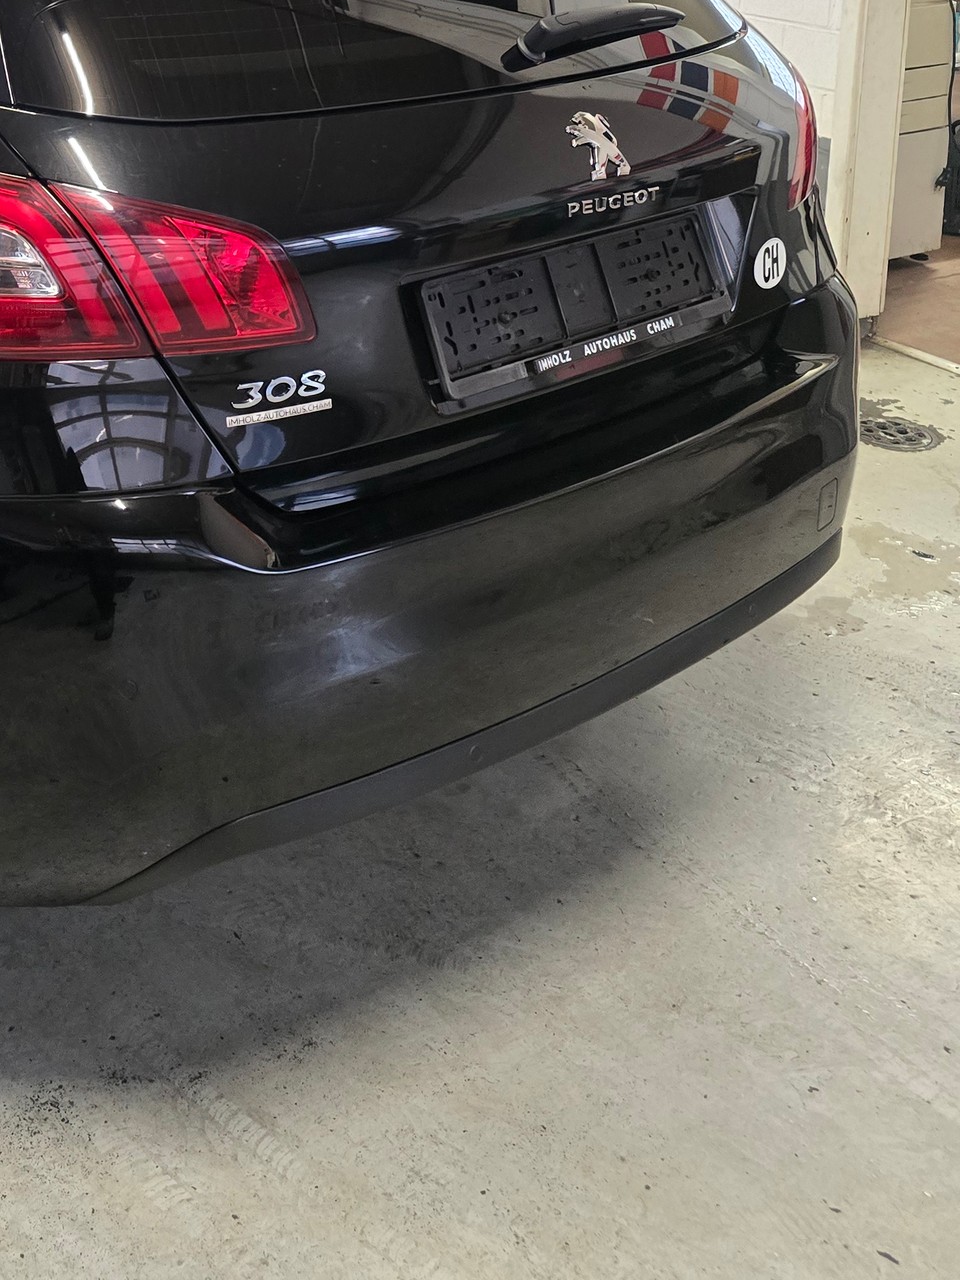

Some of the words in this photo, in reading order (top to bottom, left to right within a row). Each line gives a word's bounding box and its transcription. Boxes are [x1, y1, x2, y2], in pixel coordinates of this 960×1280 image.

[567, 186, 660, 218] PEUGEOT
[763, 242, 780, 283] CH
[538, 350, 572, 372] IMHOLZ
[584, 329, 637, 357] AUTOHAUS
[646, 316, 675, 335] CHAM
[230, 369, 327, 409] 308
